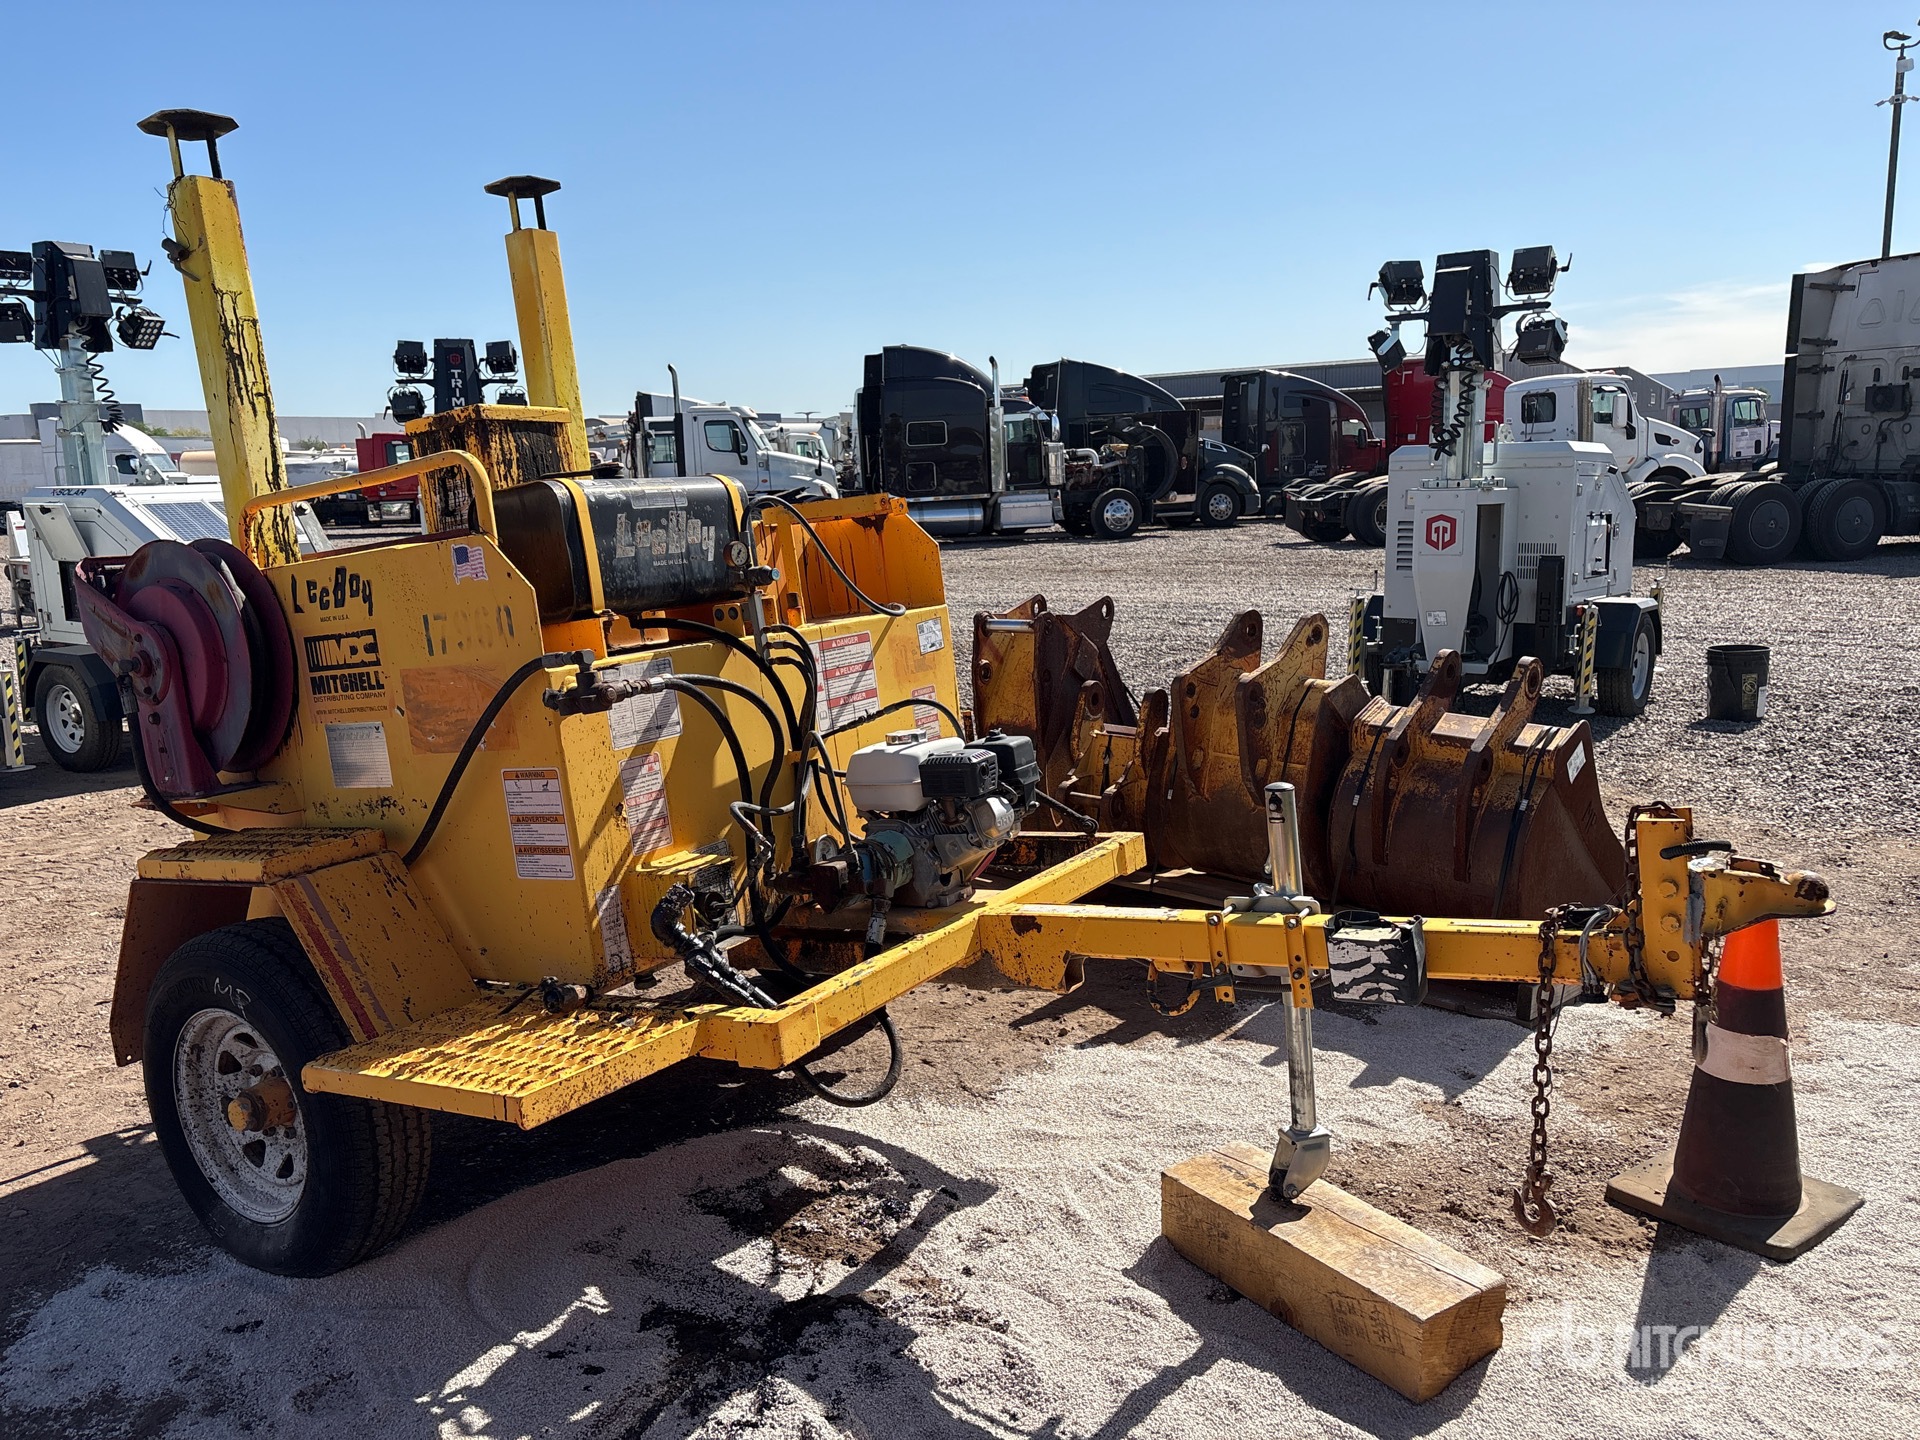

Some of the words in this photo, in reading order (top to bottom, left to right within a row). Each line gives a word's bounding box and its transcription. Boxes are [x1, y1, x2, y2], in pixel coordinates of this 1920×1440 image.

[450, 369, 465, 409] TRIM
[837, 636, 859, 647] DANGER
[840, 663, 863, 674] PELIGRO
[310, 670, 385, 695] MITCHELL
[314, 693, 355, 703] DISTRIBUTING
[356, 691, 386, 700] COMPANY
[522, 846, 566, 854] AVERTISSEMENT
